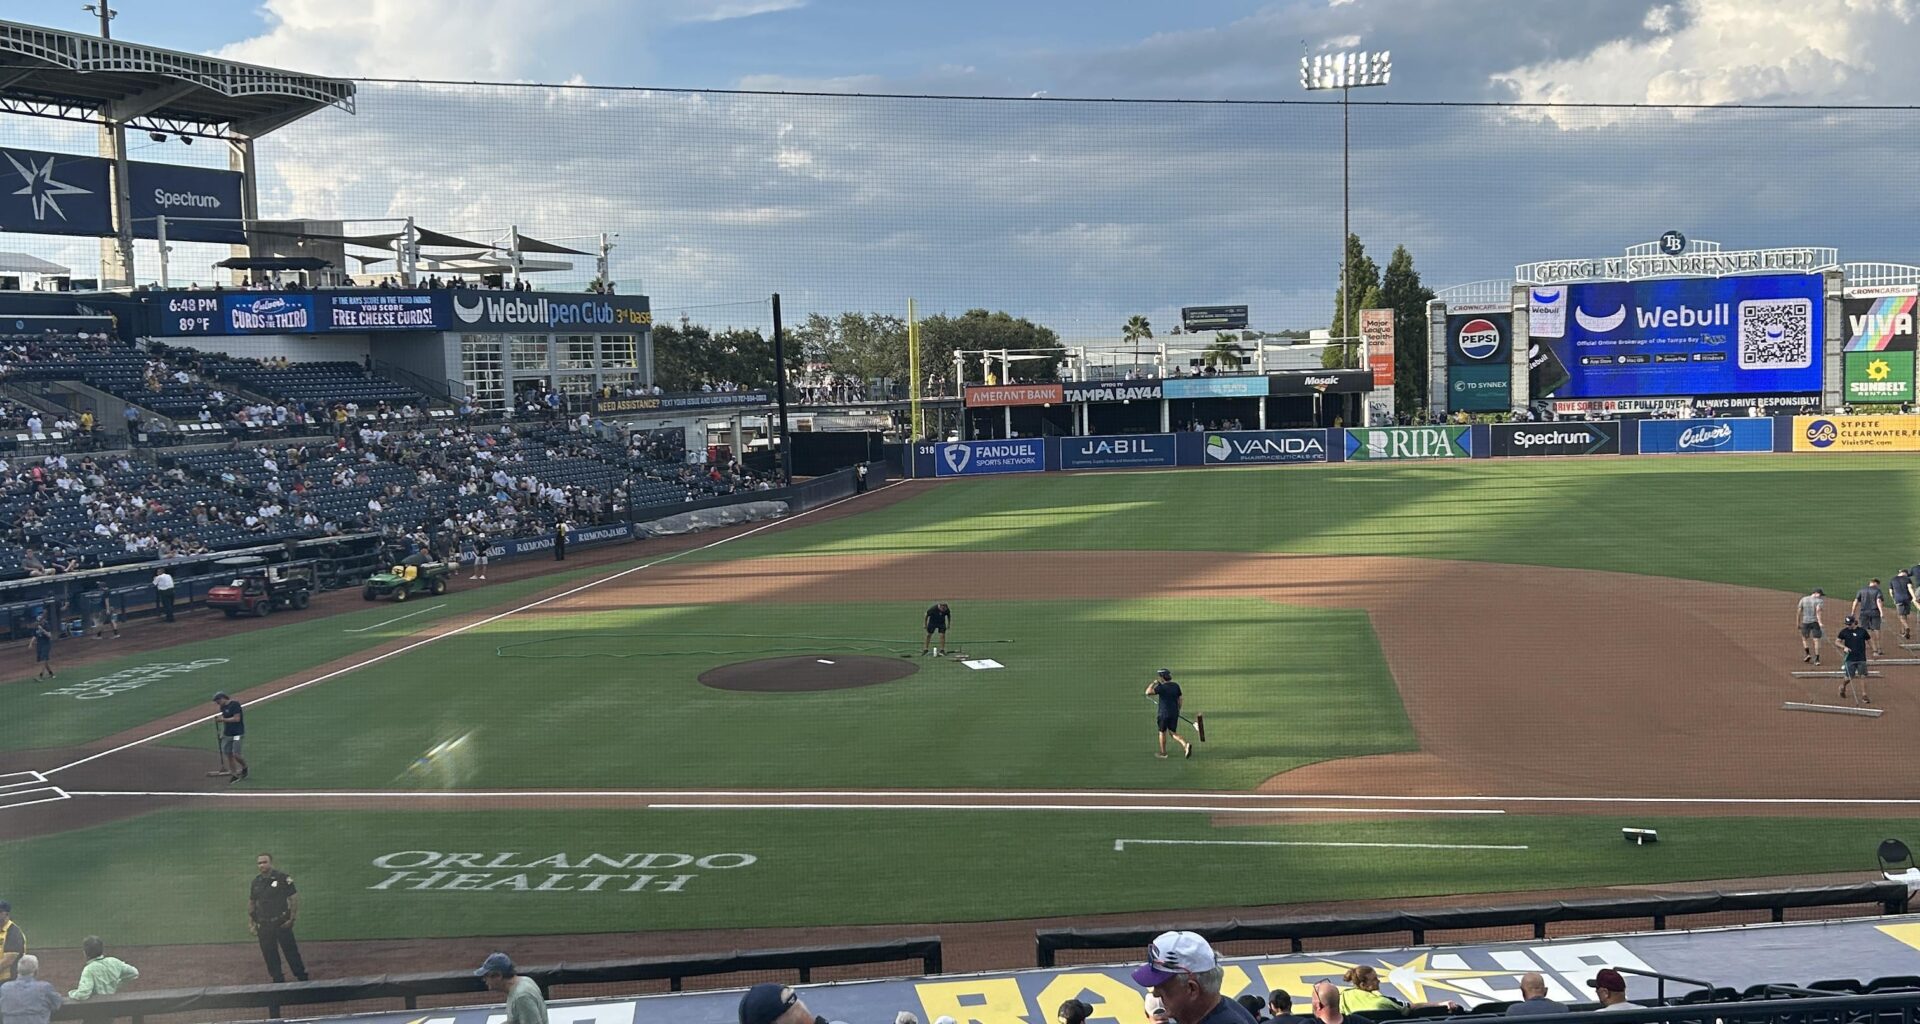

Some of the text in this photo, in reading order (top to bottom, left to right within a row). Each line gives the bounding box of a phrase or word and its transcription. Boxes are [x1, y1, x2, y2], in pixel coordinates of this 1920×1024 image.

[155, 188, 216, 208] Spectrum
[1664, 235, 1681, 251] TB
[1537, 251, 1814, 279] GEORGE M. STEINBRENNER FIELD
[1851, 287, 1917, 295] CROWNCARS.com
[169, 299, 217, 312] 6:48 PM
[582, 301, 613, 324] Club
[629, 309, 651, 324] base
[1531, 306, 1559, 314] Webull
[231, 309, 266, 328] CURDS
[275, 309, 307, 328] THIRD
[332, 307, 433, 325] FREE CHEESE CURDS!
[1635, 303, 1729, 329] Webull
[179, 318, 193, 331] 89
[1364, 327, 1391, 335] League
[1366, 320, 1388, 329] Major
[1849, 312, 1913, 336] VIVA
[1462, 334, 1497, 344] PEPSI
[1618, 338, 1648, 346] Brokerage
[1667, 337, 1687, 345] Tampa
[1305, 375, 1339, 386] Mosaic
[1478, 381, 1508, 389] SYNNEX
[973, 389, 1056, 402] AMERANT BANK
[1063, 386, 1162, 402] TAMPA BAY44
[598, 401, 616, 411] NEED
[617, 399, 660, 410] ASSISTANCE?
[1552, 401, 1576, 411] DRIVE
[1577, 401, 1602, 411] SOBER
[1603, 401, 1615, 410] OR
[1617, 401, 1632, 410] GET
[1696, 396, 1819, 409] ALWAYS DRIVE RESPONSIBLY!
[1513, 430, 1590, 448] Spectrum
[1679, 424, 1732, 448] Culver's
[1841, 430, 1911, 438] CLEARWATER,
[1081, 439, 1154, 454] JABIL
[1233, 438, 1324, 454] VANDA
[1390, 429, 1455, 458] RIPA
[1841, 439, 1892, 447] VisitSPC.com
[919, 446, 934, 455] 318
[976, 444, 1036, 458] FANDUEL
[976, 457, 1036, 467] SPORTS NETWORK
[579, 530, 608, 542] RAYMOND
[608, 526, 628, 537] JAMES
[516, 539, 550, 553] RAYMOND
[371, 850, 758, 869] ORLANDO
[366, 870, 698, 892] HEALTH
